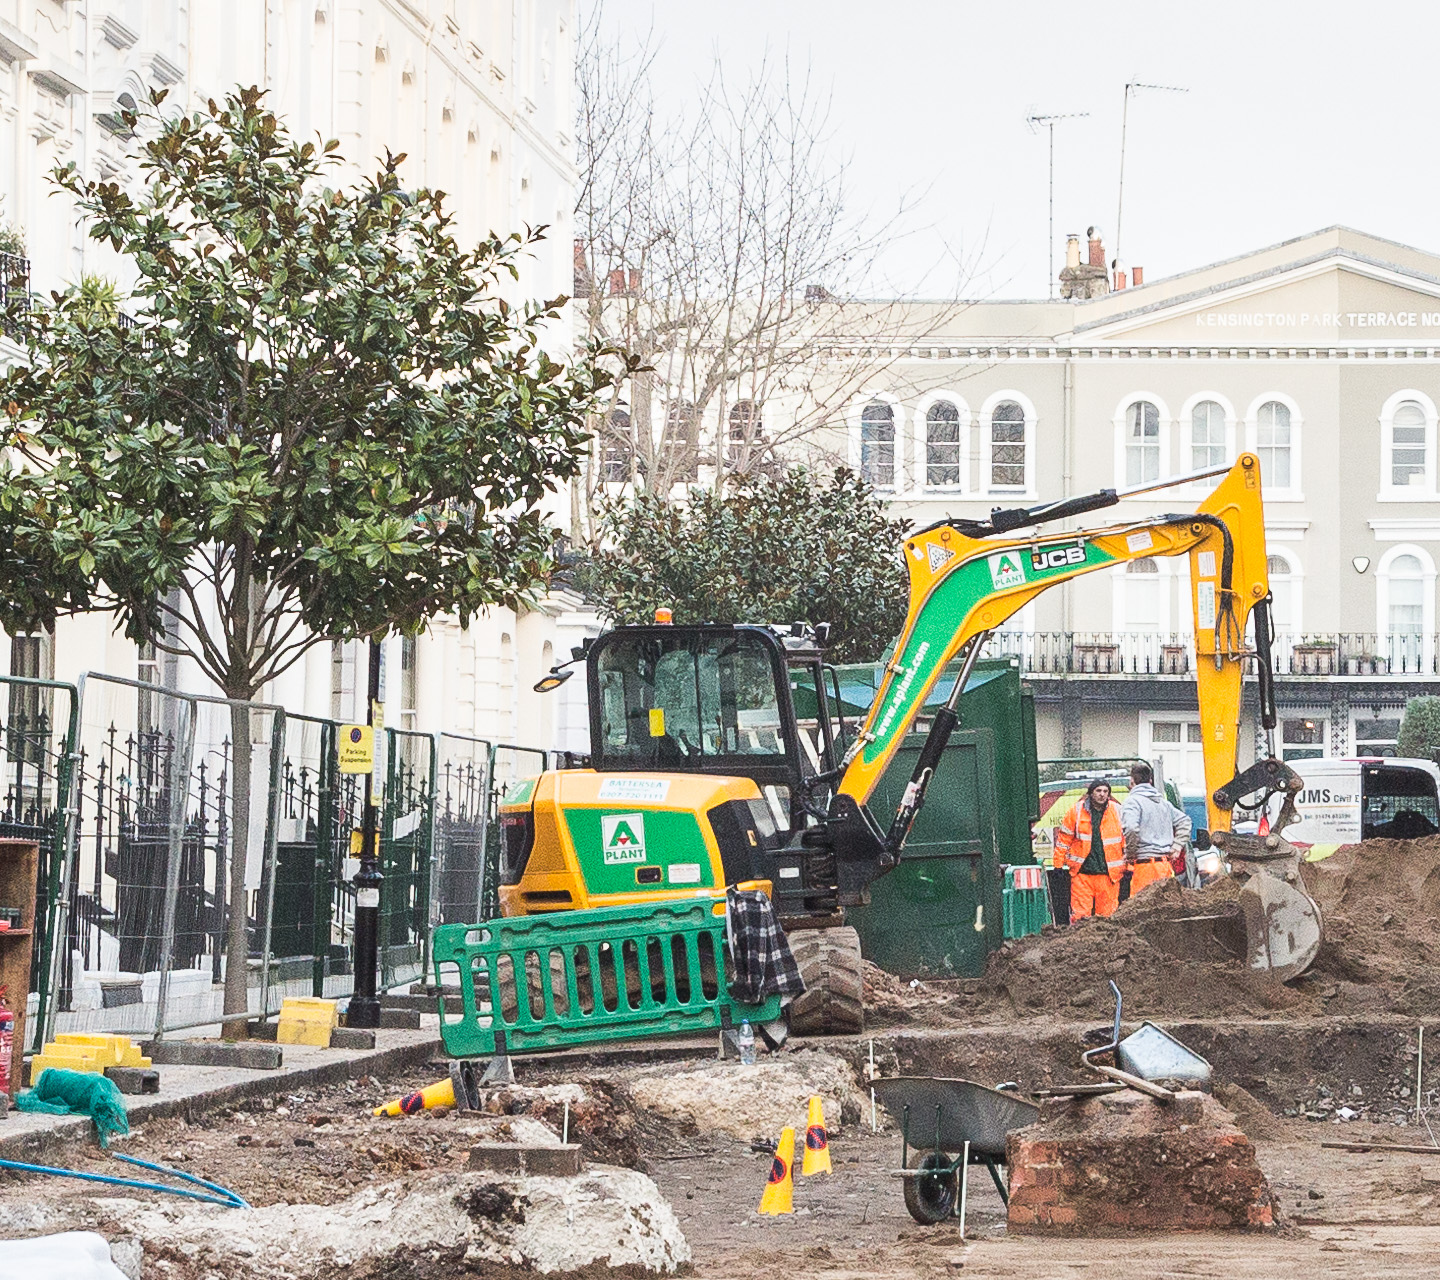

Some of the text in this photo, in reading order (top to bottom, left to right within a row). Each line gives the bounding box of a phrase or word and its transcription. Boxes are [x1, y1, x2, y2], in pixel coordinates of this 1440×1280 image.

[1196, 312, 1295, 327] KENSINGTON
[1300, 312, 1343, 327] PARK
[1346, 311, 1417, 327] TERRACE
[996, 555, 1019, 576] A
[1033, 548, 1086, 570] JCB
[994, 574, 1023, 587] PLANT
[877, 641, 930, 736] www.aplant.com
[340, 755, 372, 763] Suspension
[346, 748, 367, 756] Parking
[609, 780, 662, 788] BATTERSEA
[1298, 788, 1331, 804] JMS
[609, 820, 640, 847] A
[605, 849, 644, 861] PLANT
